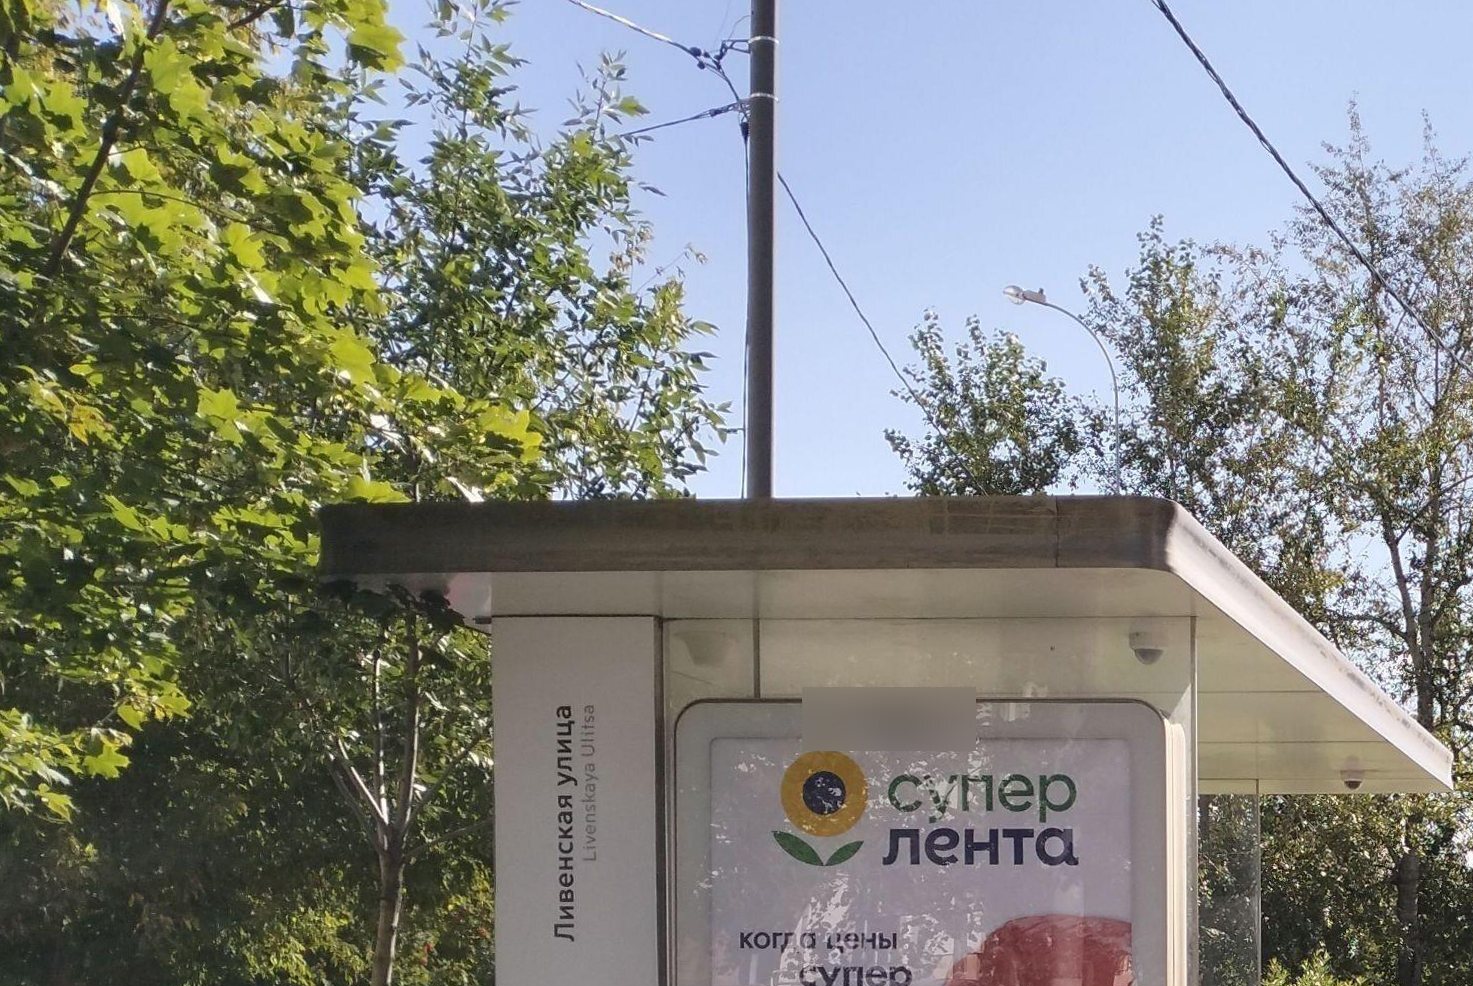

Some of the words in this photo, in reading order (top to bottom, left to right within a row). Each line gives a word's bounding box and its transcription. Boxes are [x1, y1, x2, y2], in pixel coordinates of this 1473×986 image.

[556, 704, 578, 786] улица
[580, 703, 595, 757] Ulitsa
[581, 762, 598, 862] Livenskaya
[887, 774, 1078, 823] супер
[554, 795, 575, 942] Ливенская
[882, 827, 1080, 866] лента
[739, 930, 816, 953] когда
[826, 930, 898, 954] цены
